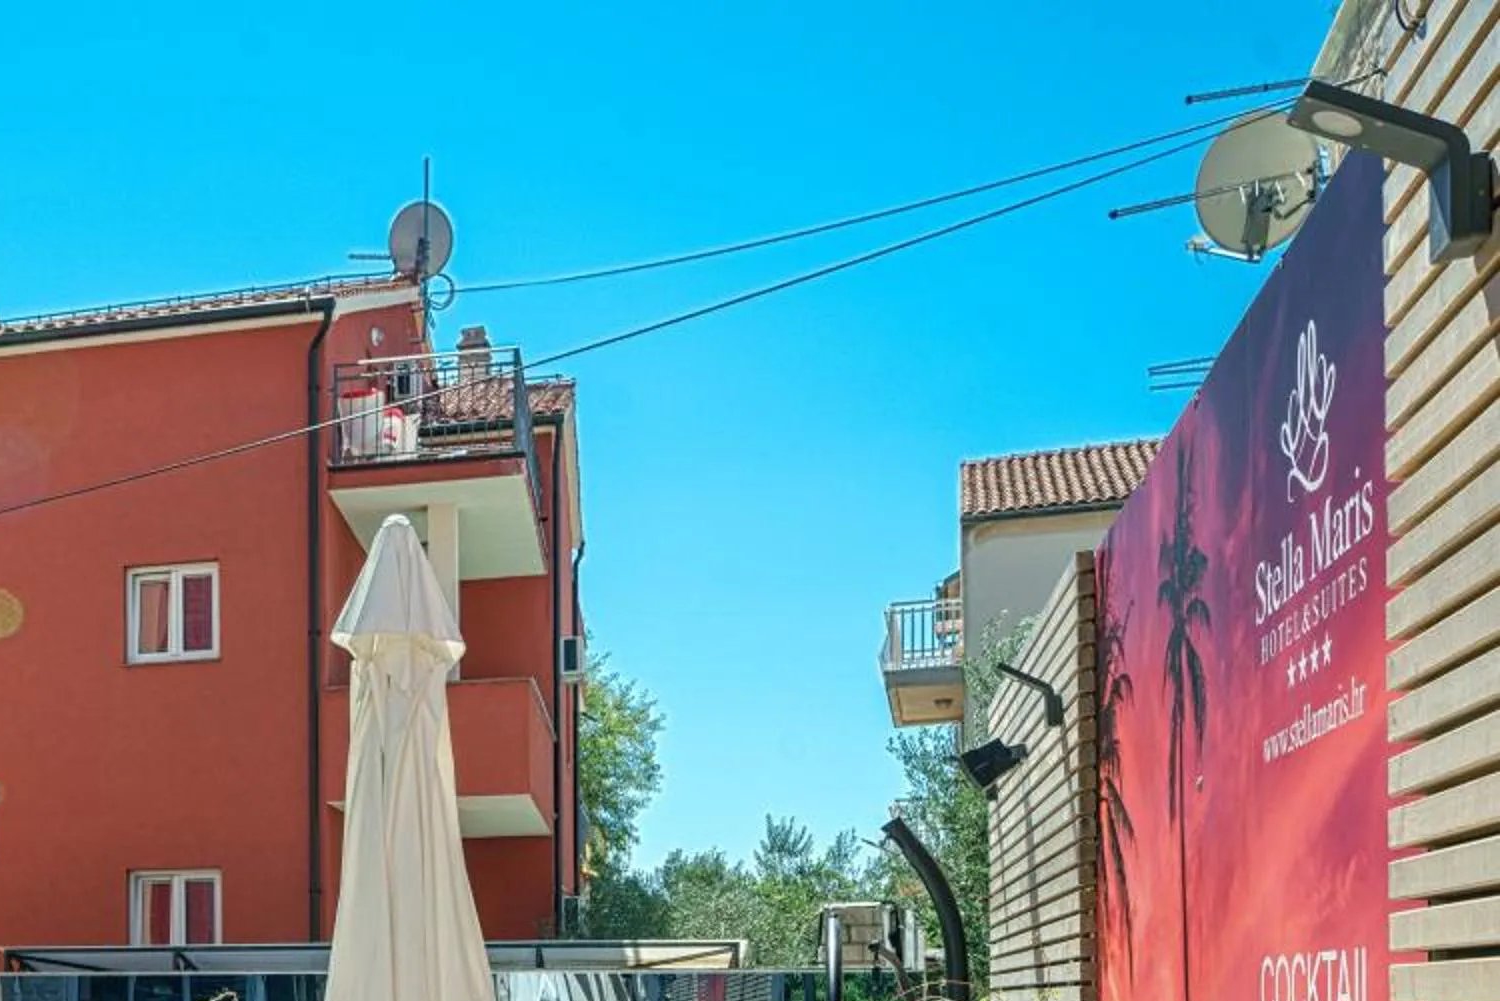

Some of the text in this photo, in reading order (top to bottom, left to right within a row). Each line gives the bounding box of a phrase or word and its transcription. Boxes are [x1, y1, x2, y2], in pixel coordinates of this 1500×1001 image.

[1255, 466, 1374, 626] Stella Maris
[1260, 556, 1368, 666] HOTEL&SUITES
